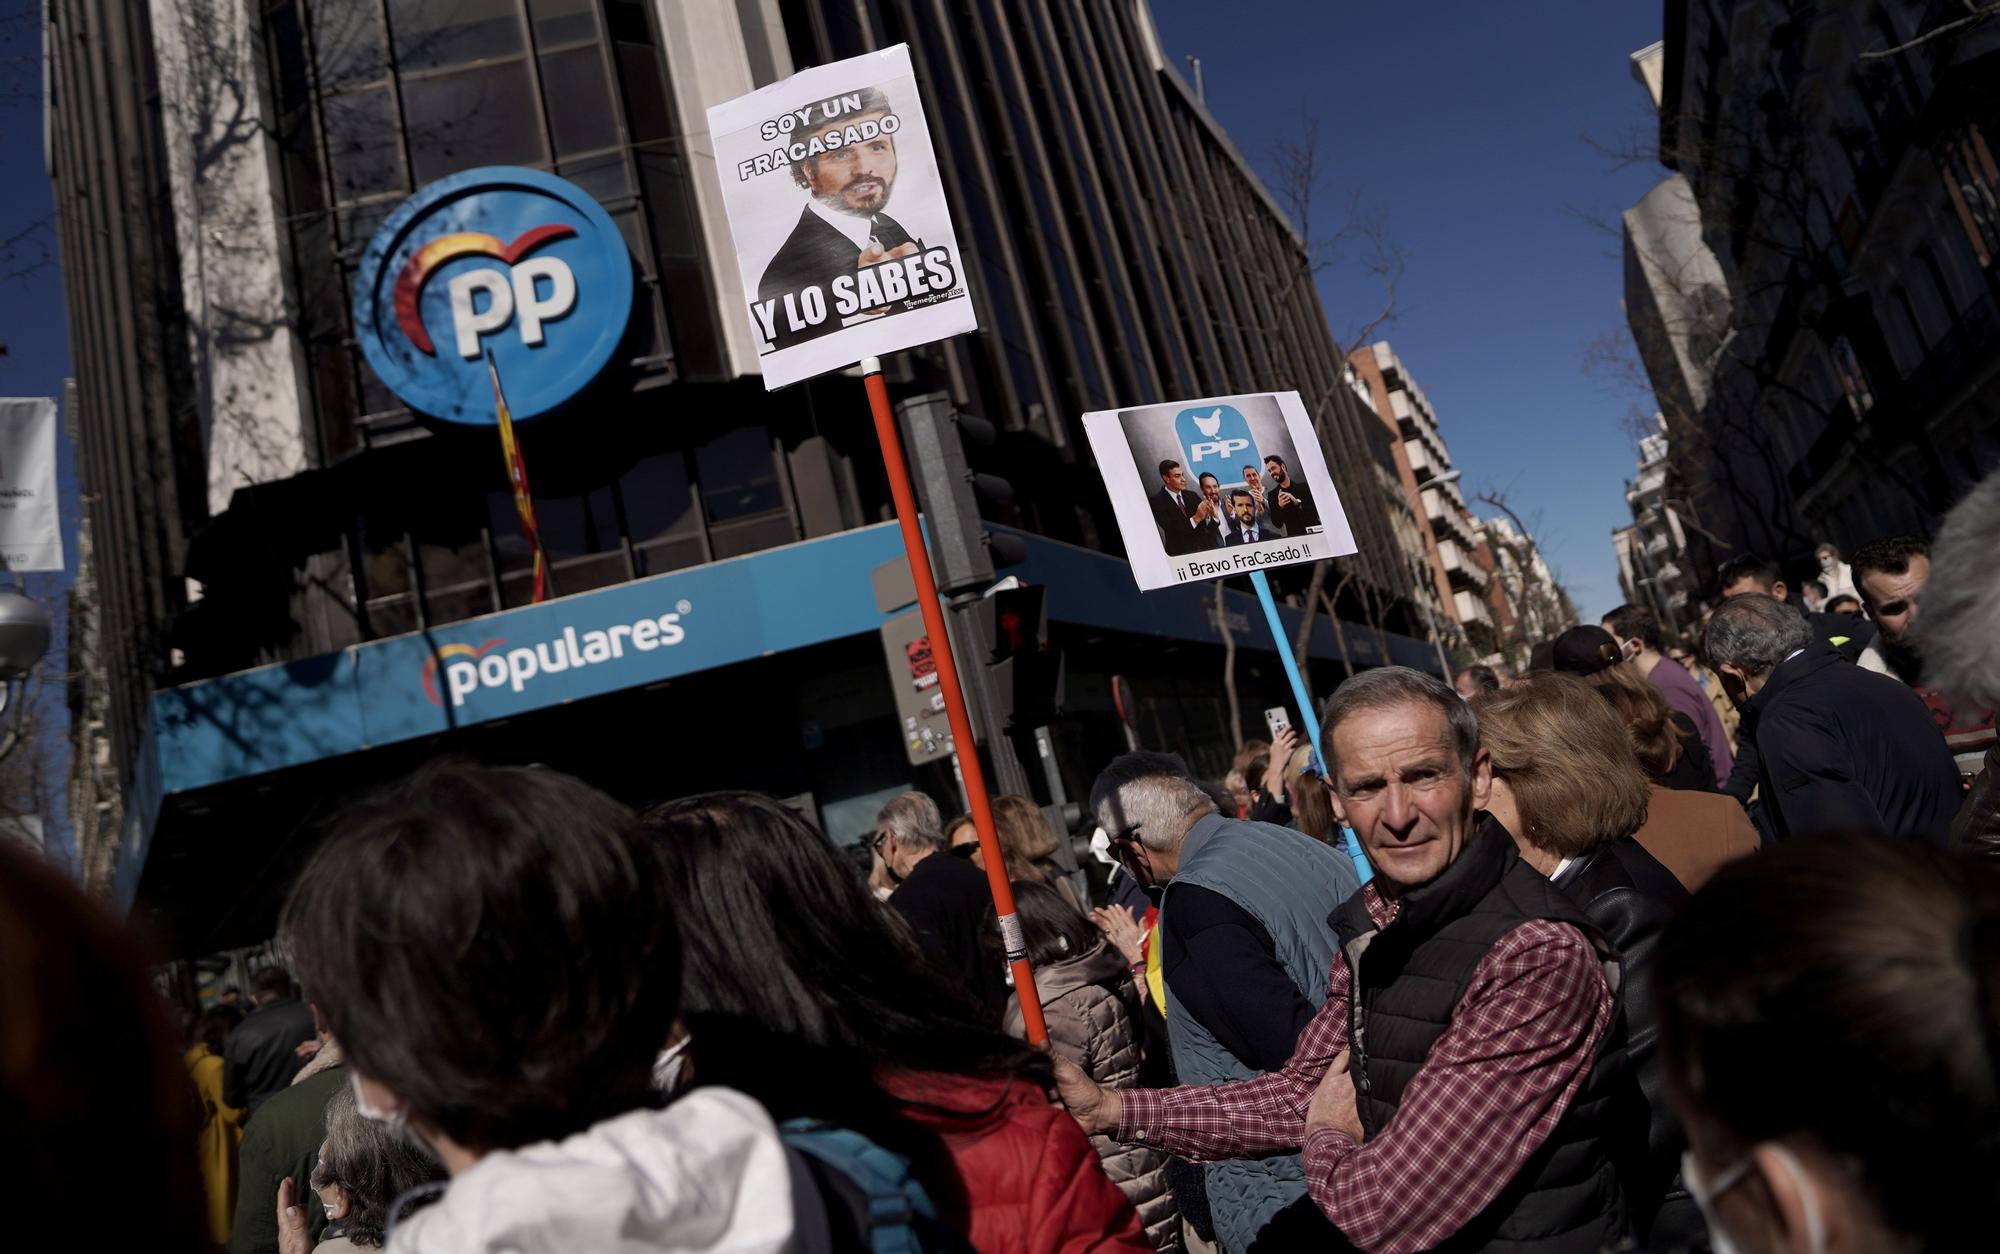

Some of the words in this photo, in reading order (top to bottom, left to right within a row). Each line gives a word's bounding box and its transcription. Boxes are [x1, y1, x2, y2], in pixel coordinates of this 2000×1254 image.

[760, 106, 812, 141] SOY
[822, 93, 863, 118] UN
[738, 114, 901, 181] FRACASADO
[753, 299, 777, 341] Y
[783, 285, 828, 333] LO
[831, 249, 953, 316] SABES
[1190, 438, 1250, 463] PP
[1188, 559, 1231, 577] Bravo
[1233, 546, 1301, 569] FraCasado
[446, 612, 686, 707] populares
